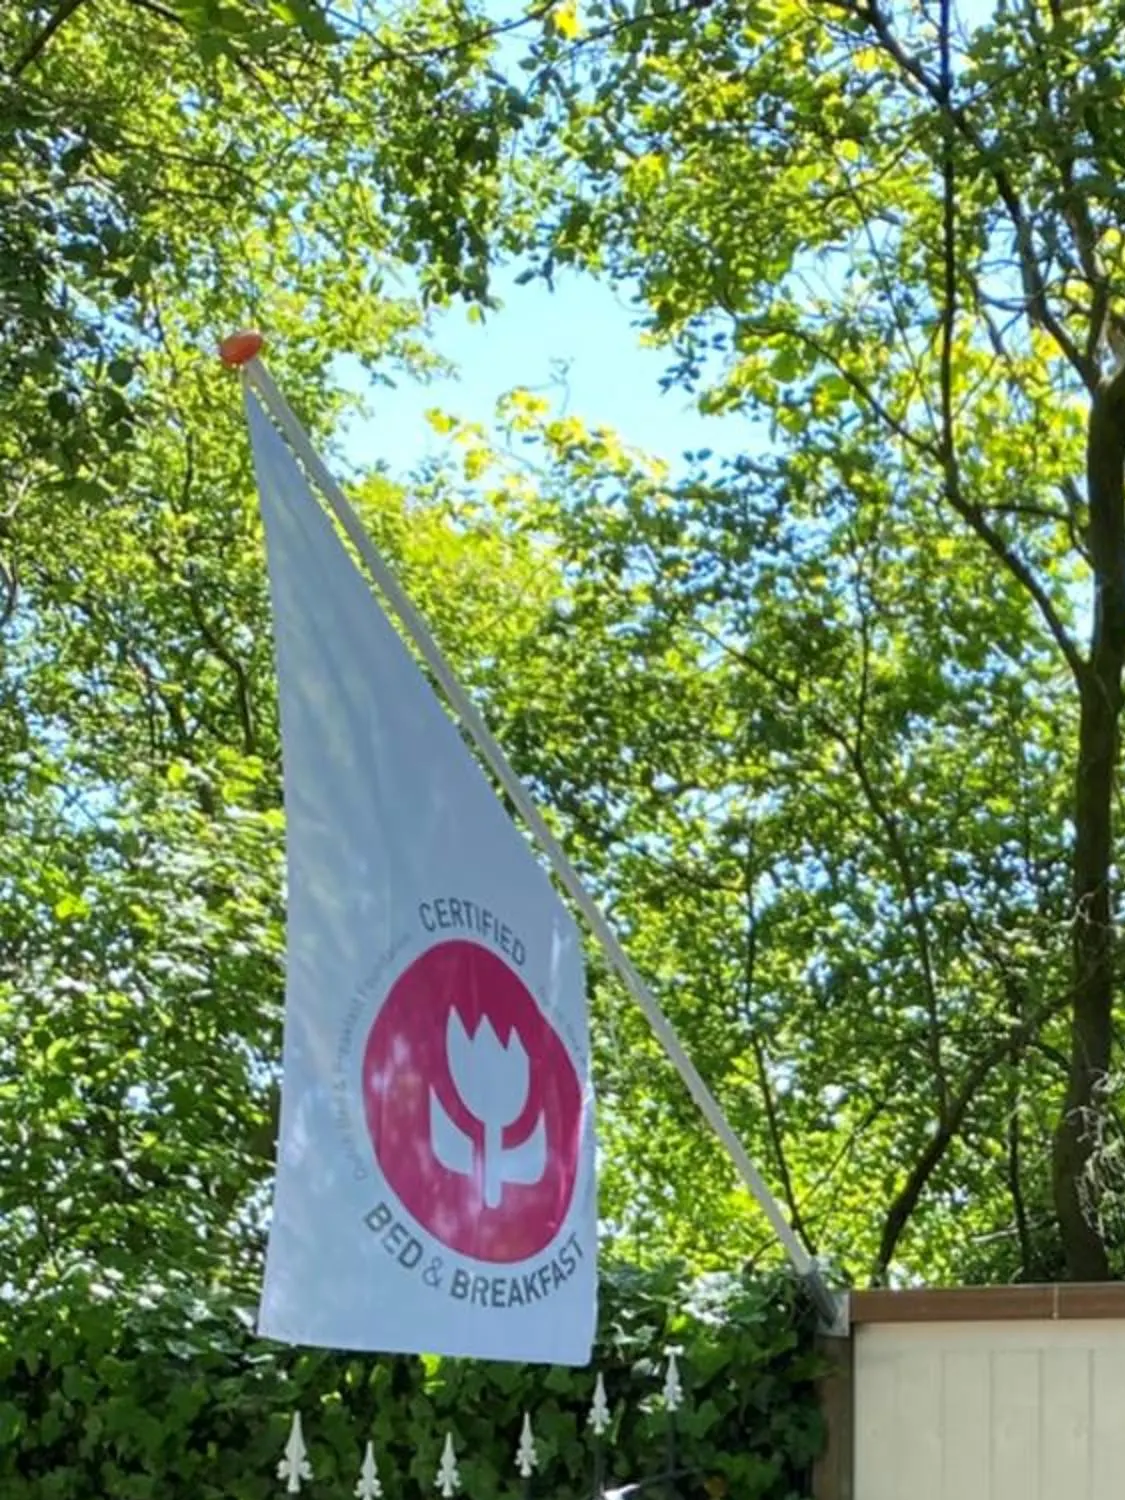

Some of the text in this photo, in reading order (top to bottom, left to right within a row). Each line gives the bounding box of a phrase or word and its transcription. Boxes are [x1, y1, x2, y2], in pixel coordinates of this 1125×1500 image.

[418, 897, 527, 967] CERTIFIED
[363, 1201, 586, 1309] BED & BREAKFAST
